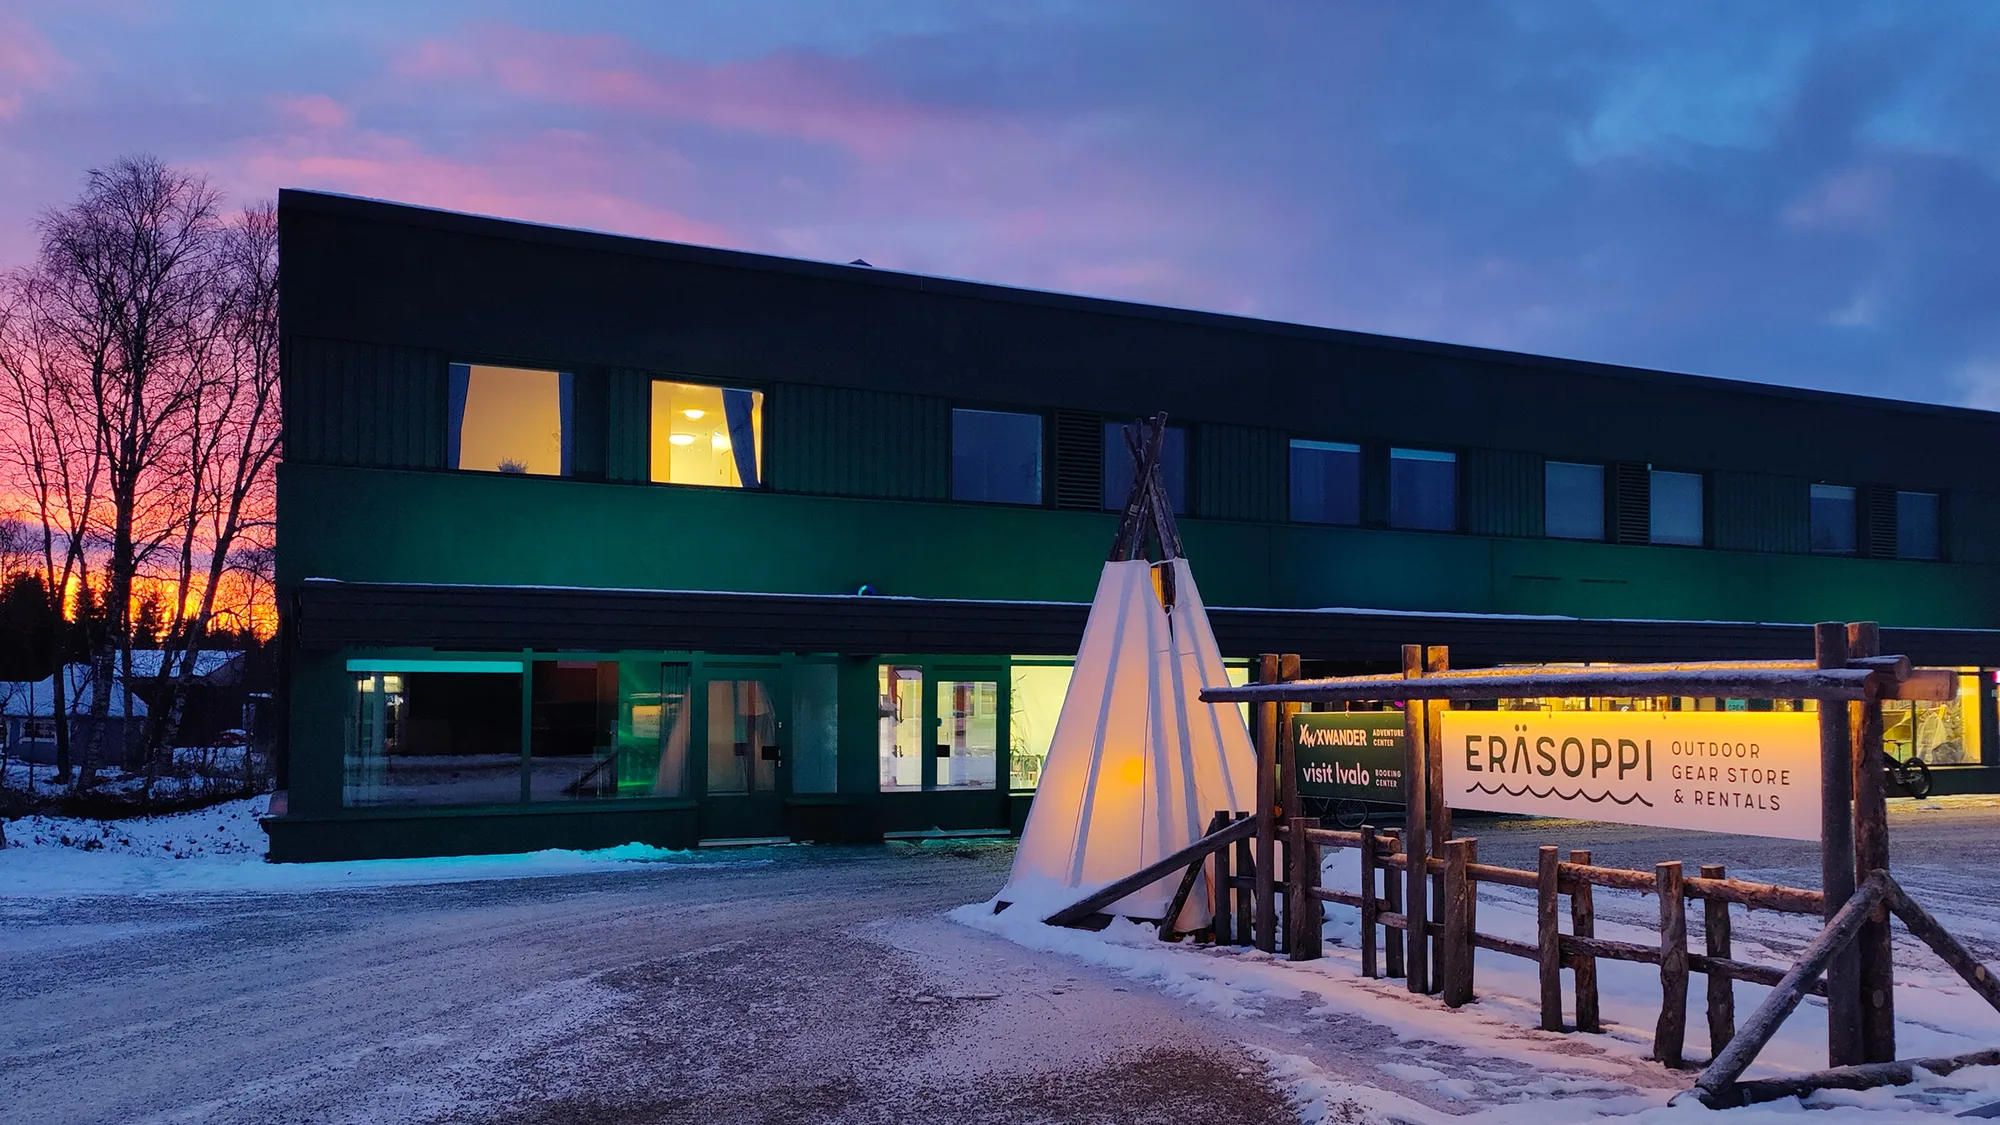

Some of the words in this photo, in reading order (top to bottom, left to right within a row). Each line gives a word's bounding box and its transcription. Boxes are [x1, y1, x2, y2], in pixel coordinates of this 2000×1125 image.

[1317, 729, 1367, 747] XWANDER
[1372, 729, 1404, 737] ADVENTURE
[1373, 739, 1394, 747] CENTER
[1671, 741, 1760, 758] OUTDOOR
[1465, 724, 1653, 781] ERÄSOPPI
[1302, 762, 1333, 783] visit
[1335, 761, 1370, 786] Ivalo
[1375, 769, 1401, 778] BOOKING
[1672, 765, 1718, 781] GEAR
[1727, 767, 1790, 785] STORE
[1375, 779, 1398, 787] CENTER
[1673, 788, 1684, 804] &
[1694, 790, 1780, 811] RENTALS
